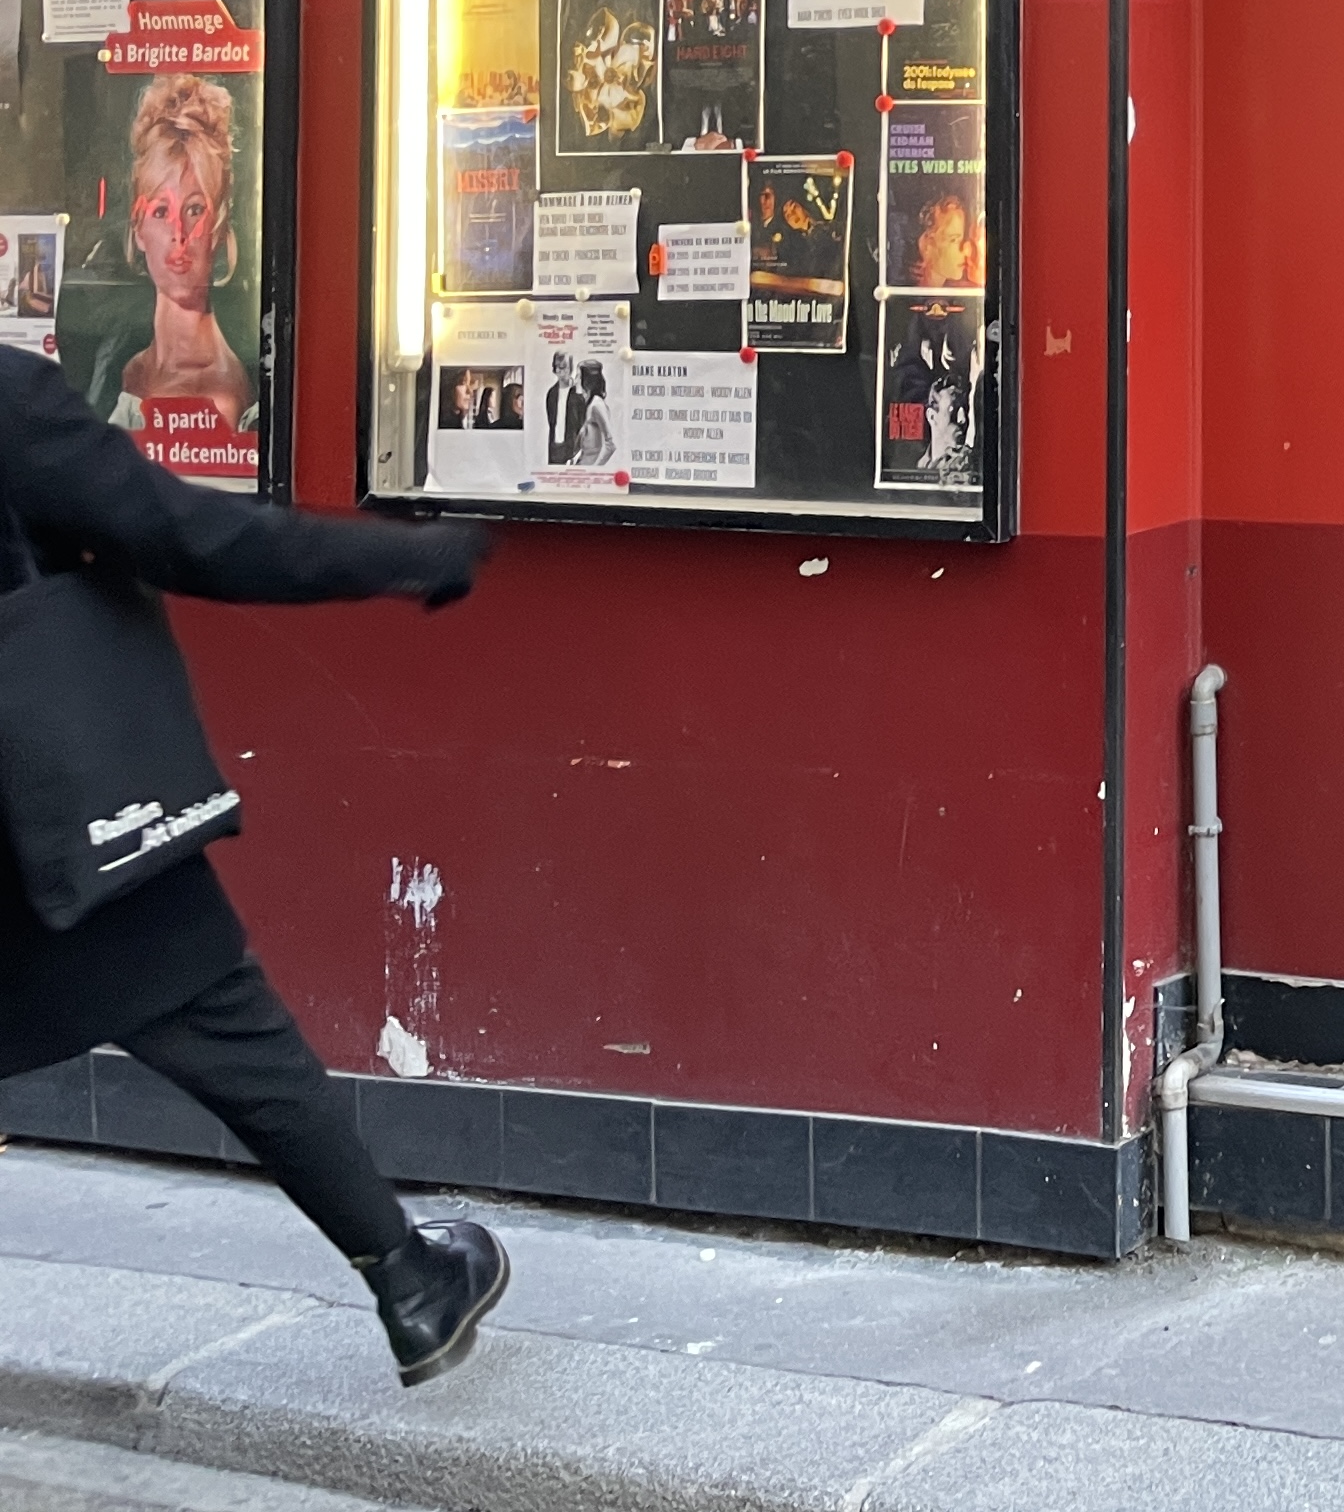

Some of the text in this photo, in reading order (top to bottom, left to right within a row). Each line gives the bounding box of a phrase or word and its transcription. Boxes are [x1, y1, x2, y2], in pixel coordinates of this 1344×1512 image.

[138, 12, 224, 34] Hommage
[113, 42, 250, 67] à Brigitte Bardot
[889, 160, 918, 174] EYES
[922, 160, 954, 173] WIDE
[632, 365, 688, 377] DIANE KEATON
[153, 408, 218, 434] à partir
[145, 441, 258, 465] 31 décembre
